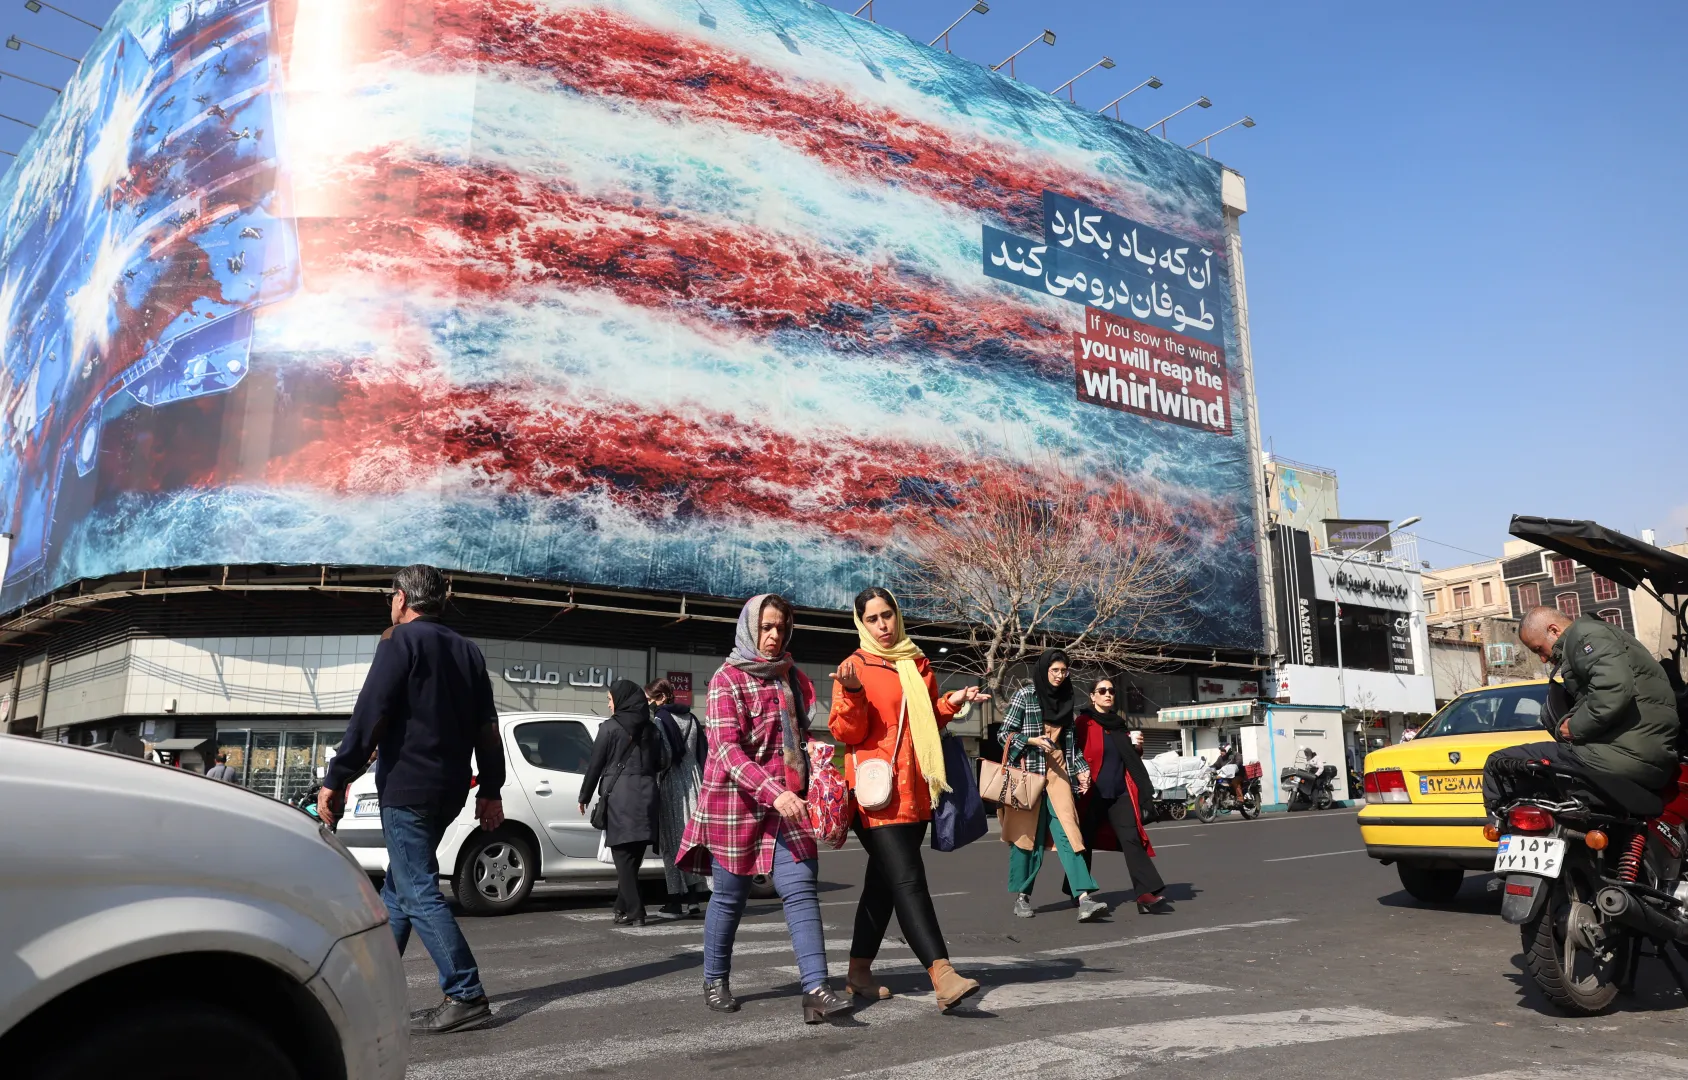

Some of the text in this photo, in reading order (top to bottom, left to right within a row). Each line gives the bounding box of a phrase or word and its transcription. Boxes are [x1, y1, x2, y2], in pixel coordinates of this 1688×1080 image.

[1051, 207, 1213, 290] آن که باد بکارد
[1130, 282, 1214, 332] طوفان
[1080, 337, 1222, 391] you will reap the
[1090, 314, 1221, 368] If you sow the wind,
[1083, 367, 1225, 429] whirlwind
[1337, 530, 1380, 540] SAMSUNG
[1300, 598, 1314, 664] SAMSUNG
[504, 663, 560, 685] ملت
[670, 675, 689, 683] 984
[1498, 854, 1555, 871] ۷۷۱۱۶
[1520, 838, 1554, 854] ۱۵۳
